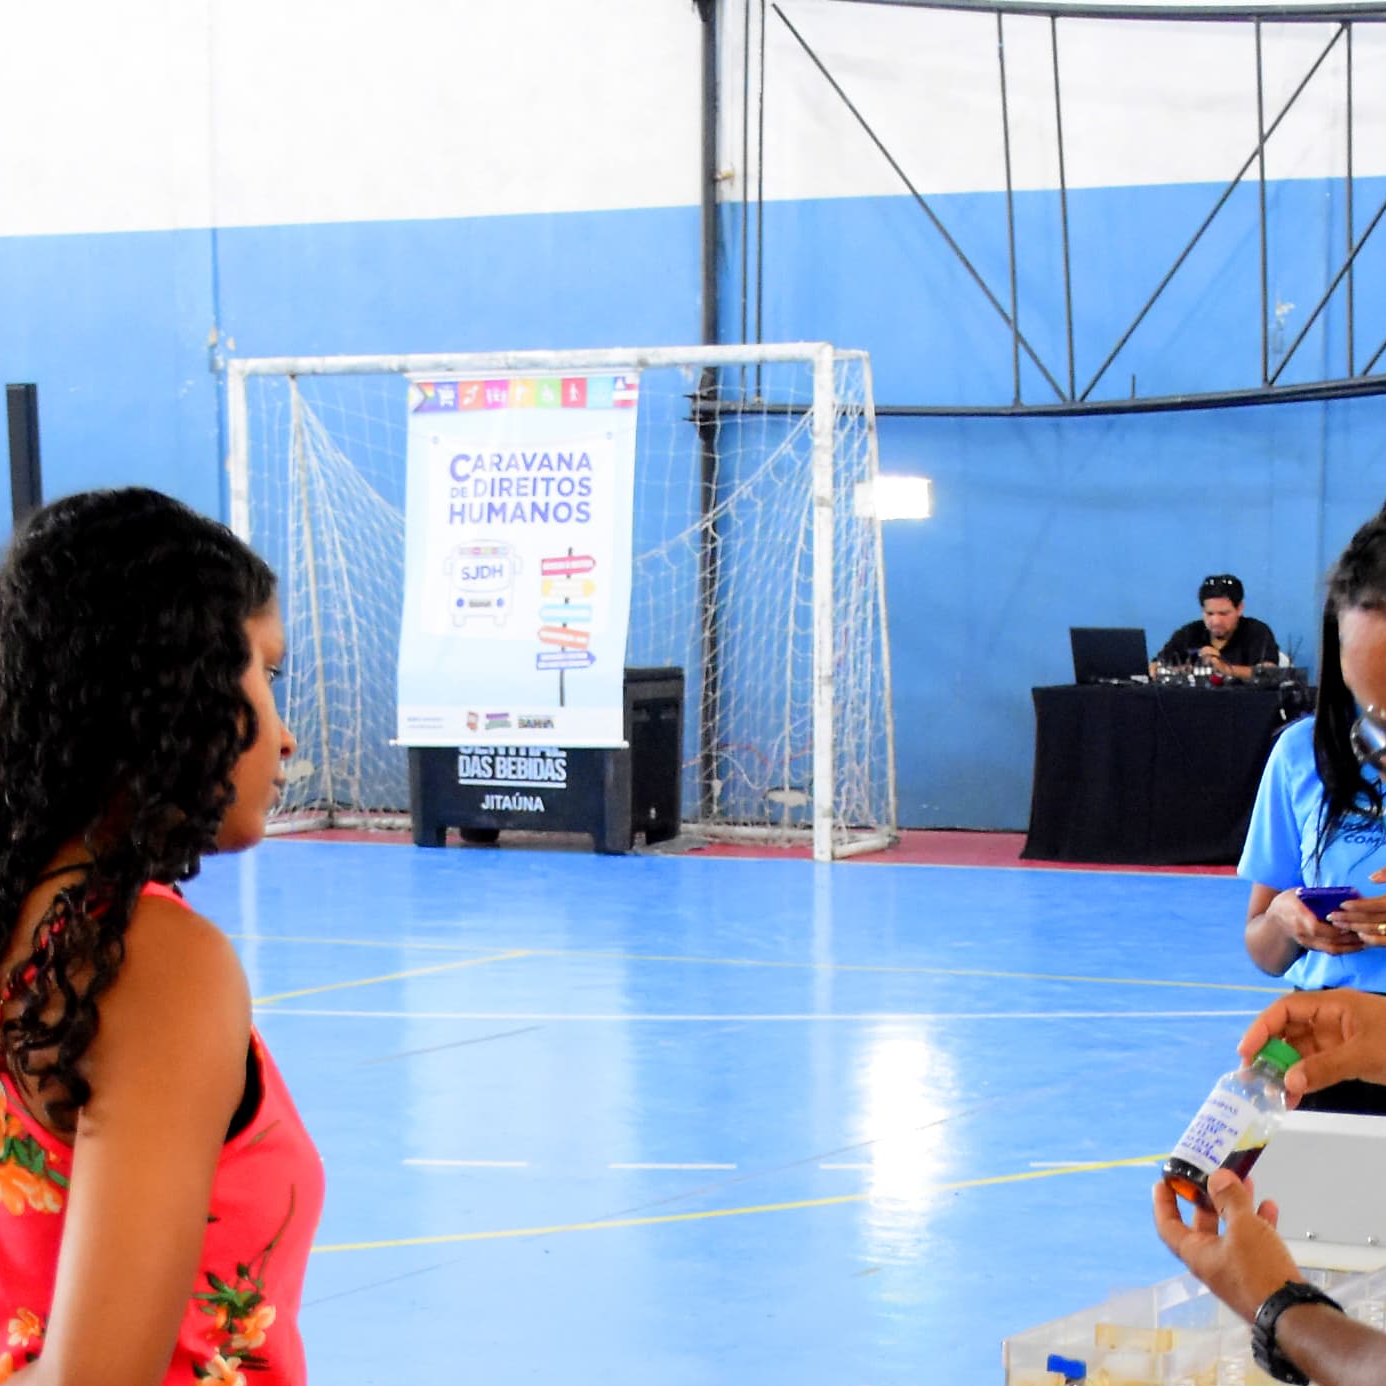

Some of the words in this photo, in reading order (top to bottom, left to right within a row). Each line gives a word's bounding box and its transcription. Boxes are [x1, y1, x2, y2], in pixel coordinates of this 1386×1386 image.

[449, 451, 593, 483] CARAVANA
[450, 486, 468, 499] DE
[472, 476, 592, 498] DIREITOS
[448, 500, 591, 525] HUMANOS
[461, 563, 504, 581] SJDH
[458, 755, 493, 779] DAS
[494, 757, 568, 782] BEBIDAS
[480, 792, 545, 813] JITAÚNA
